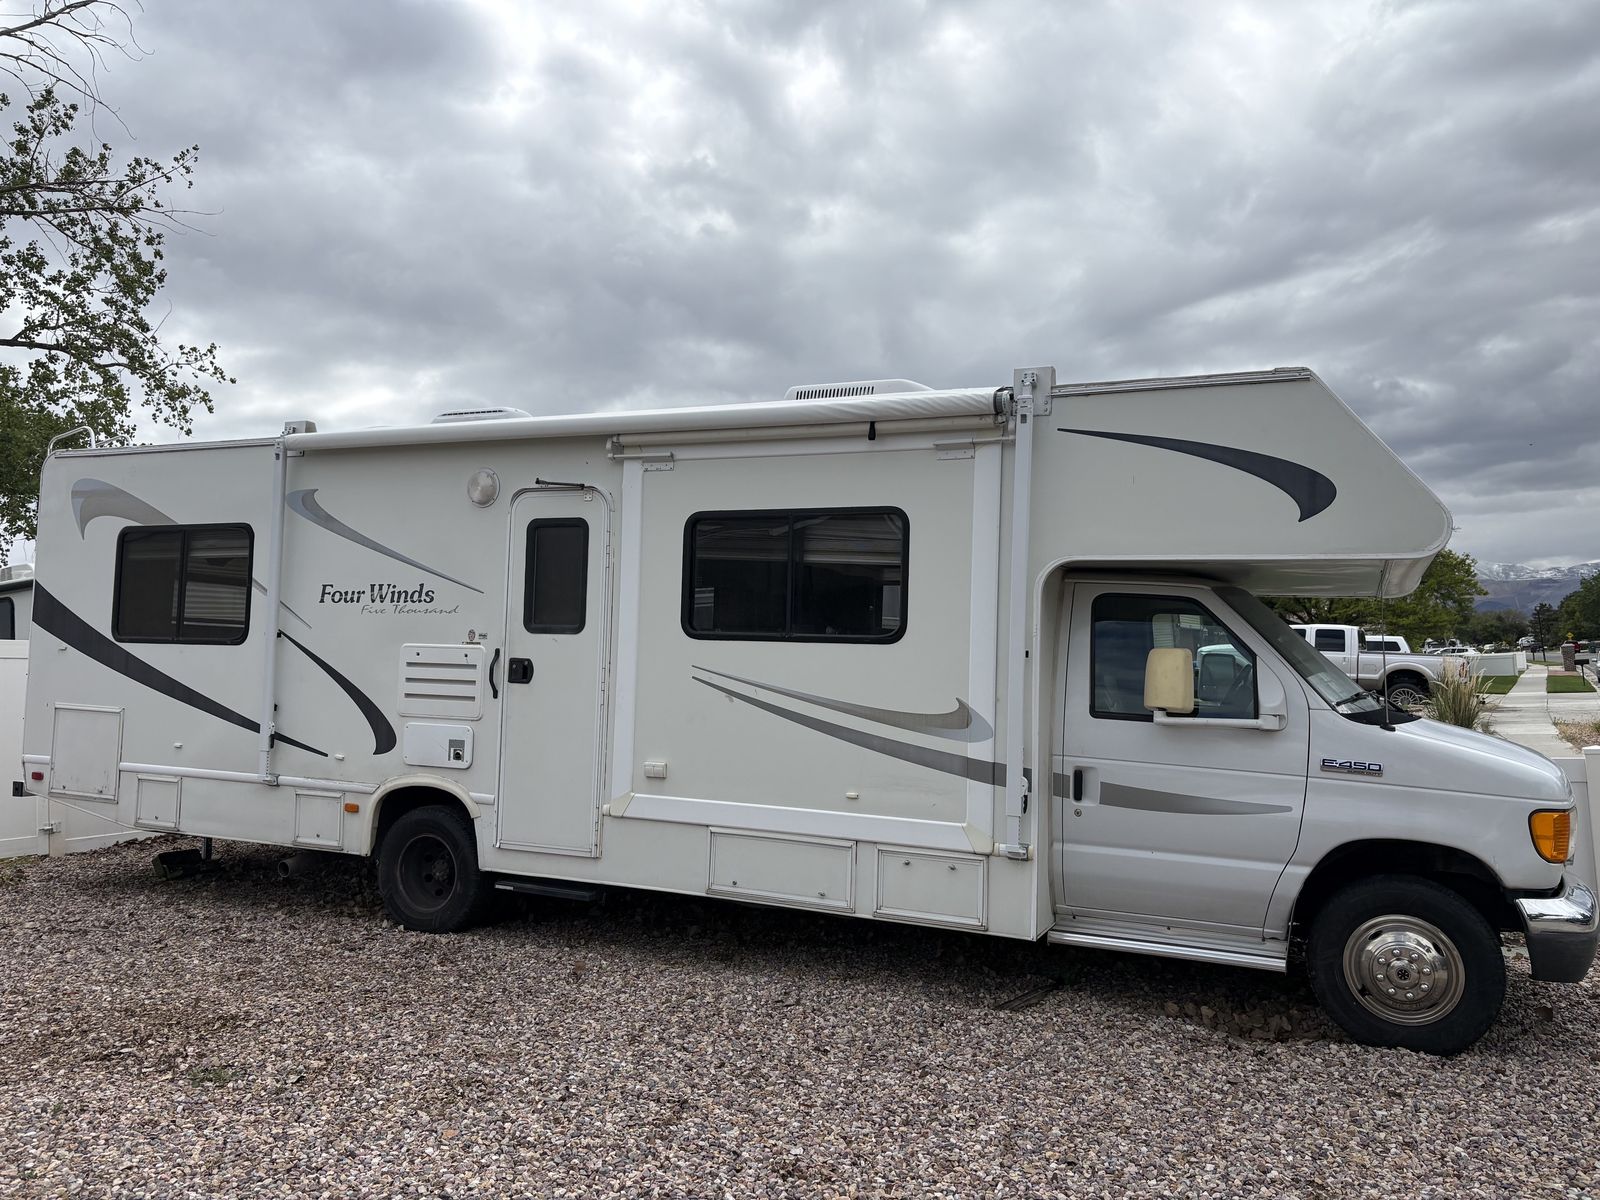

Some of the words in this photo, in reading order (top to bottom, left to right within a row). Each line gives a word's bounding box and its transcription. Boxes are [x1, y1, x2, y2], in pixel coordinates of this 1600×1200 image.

[319, 584, 365, 603] Four
[370, 583, 435, 604] Winds
[360, 604, 387, 615] Five
[392, 604, 460, 615] Thousand
[1321, 758, 1382, 772] E-450
